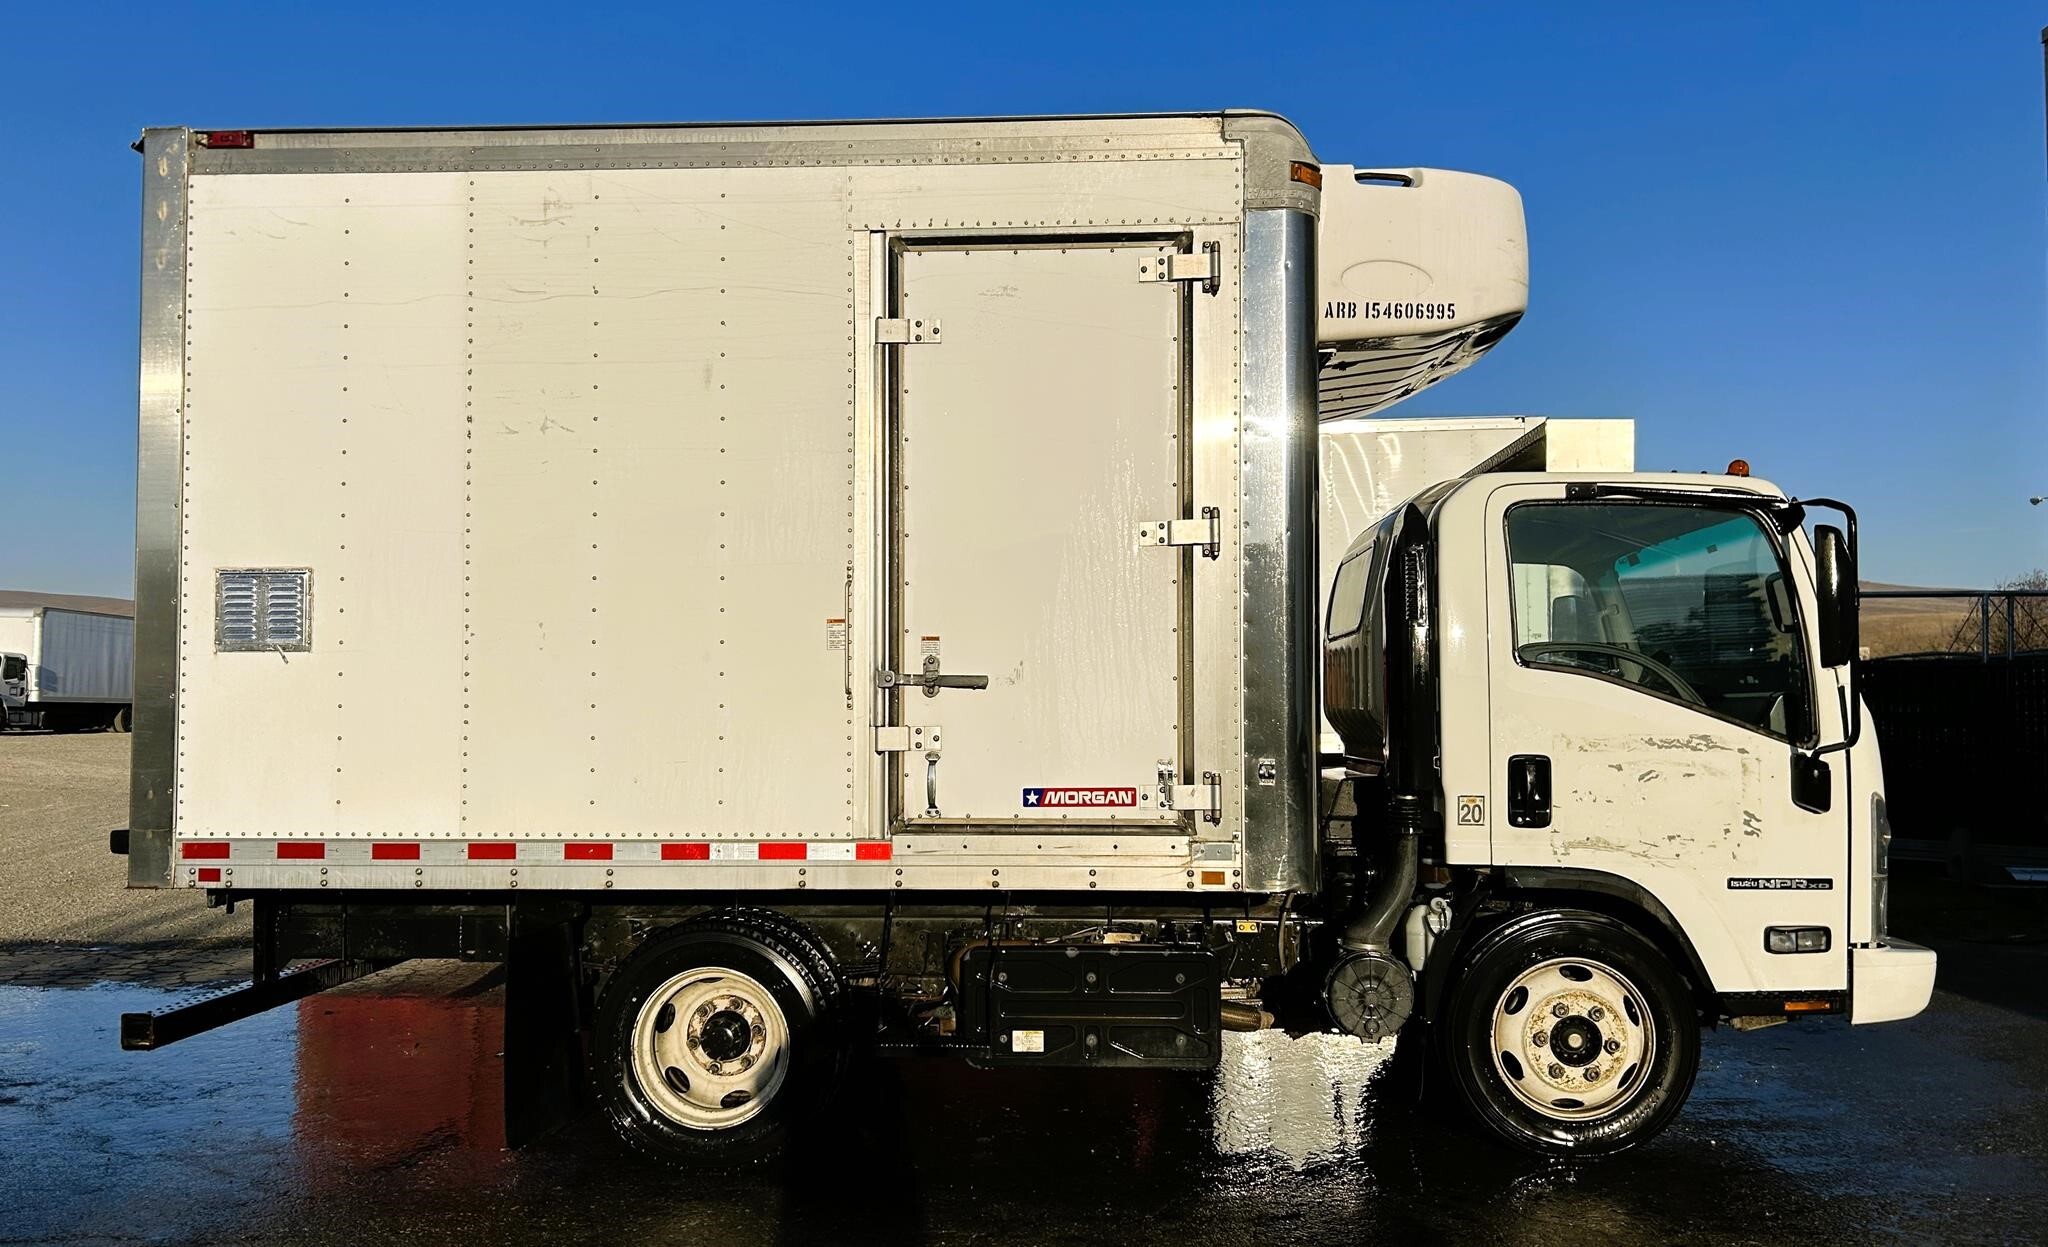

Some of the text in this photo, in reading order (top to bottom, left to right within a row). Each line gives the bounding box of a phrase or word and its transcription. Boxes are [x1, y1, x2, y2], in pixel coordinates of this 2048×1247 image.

[1324, 301, 1456, 320] ARB 154606995
[1043, 791, 1132, 805] MORGAN
[1460, 803, 1483, 823] 20
[1759, 878, 1808, 889] NPR
